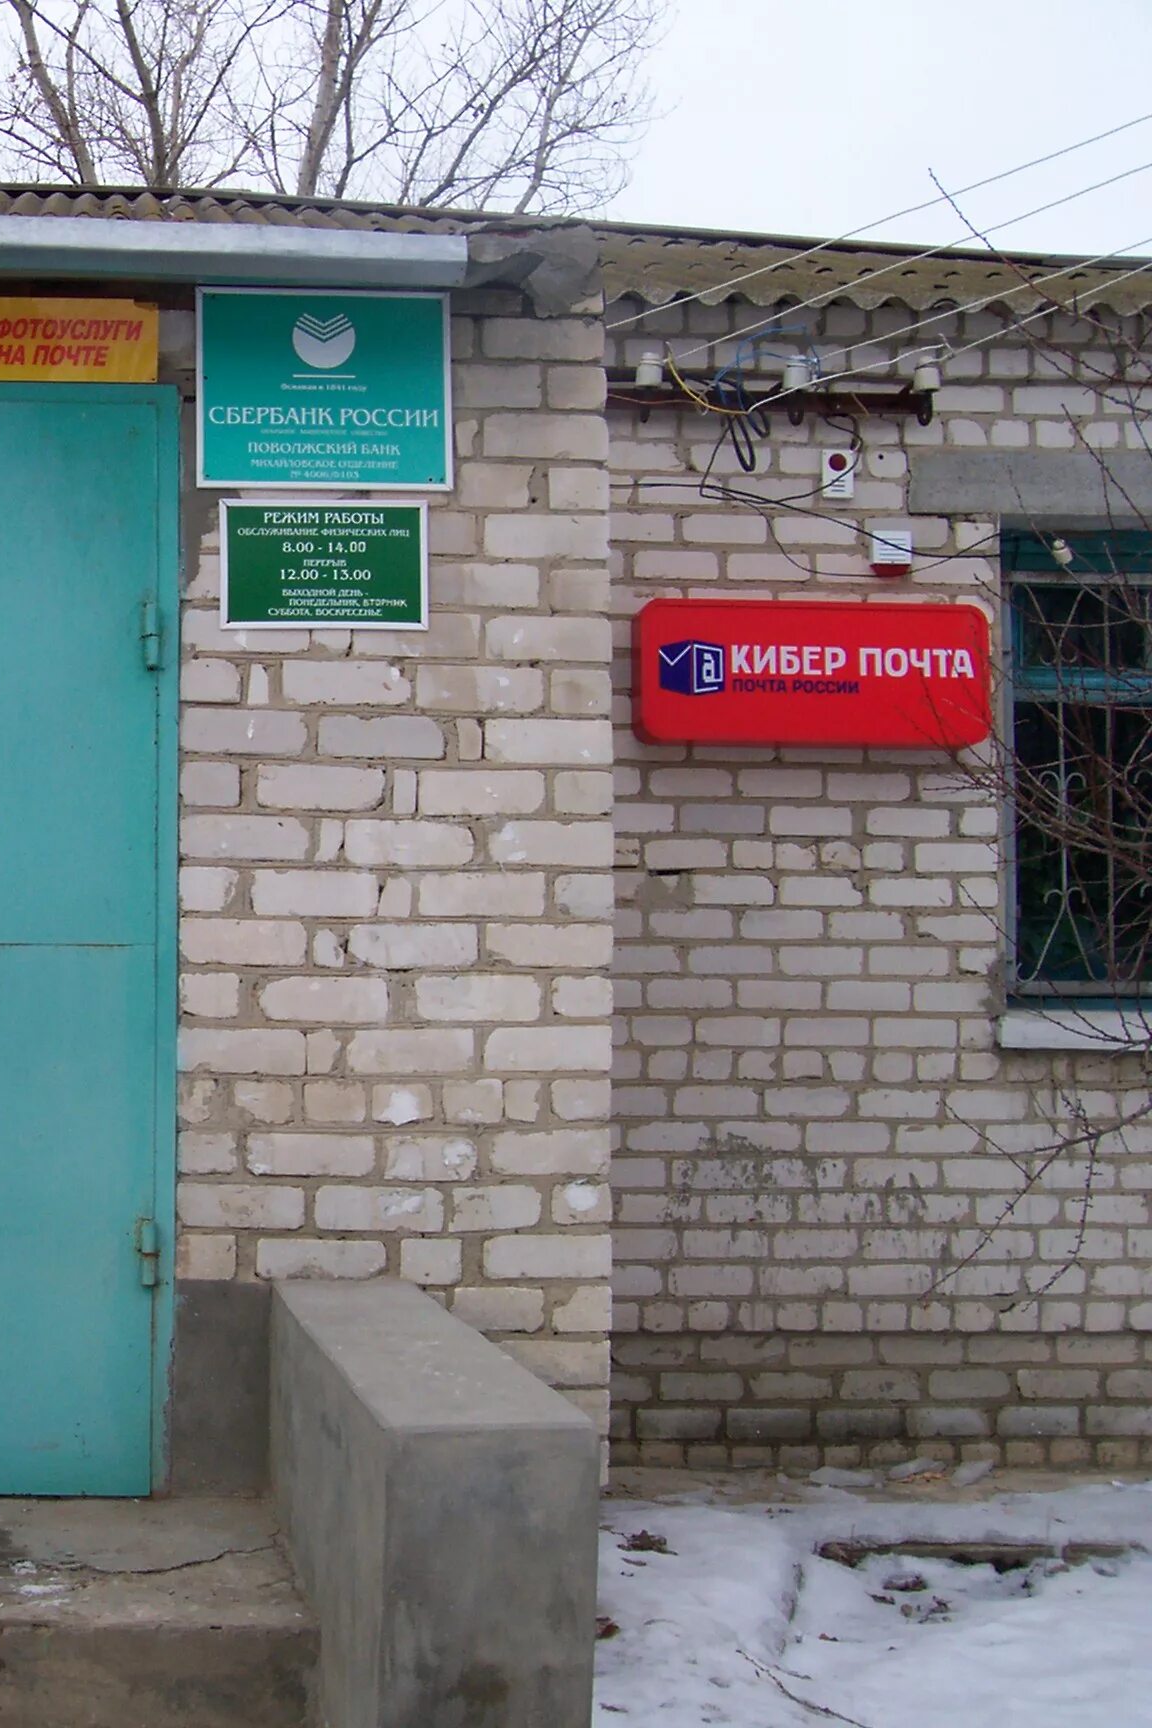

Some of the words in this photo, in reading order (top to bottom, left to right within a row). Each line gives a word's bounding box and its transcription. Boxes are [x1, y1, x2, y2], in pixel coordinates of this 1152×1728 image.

[32, 345, 111, 367] ПОЧТЕ
[209, 406, 334, 426] СБЕРБАНК
[340, 409, 439, 428] РОССИИ
[248, 440, 357, 456] ПОВОЛЖСКИЙ
[361, 446, 401, 456] БАНК
[264, 512, 319, 524] РЕЖИМ
[324, 512, 384, 525] РАБОТЫ
[237, 528, 318, 537] ОБСЛУЖИВАНИЕ
[320, 528, 387, 538] ФИЗИЧЕСКИХ
[388, 529, 410, 538] ЛИЦ
[282, 542, 314, 553] 8.00
[327, 541, 367, 553] 14.00
[303, 559, 347, 567] ПЕРЕРЫВ
[280, 569, 318, 581] 12.00
[332, 569, 372, 581] 13.00
[282, 587, 335, 597] ВЫХОДНОЙ
[731, 645, 846, 676] КИБЕР
[859, 648, 975, 679] ПОЧТА
[733, 679, 787, 693] ПОЧТА
[792, 679, 860, 694] РОССИИ
